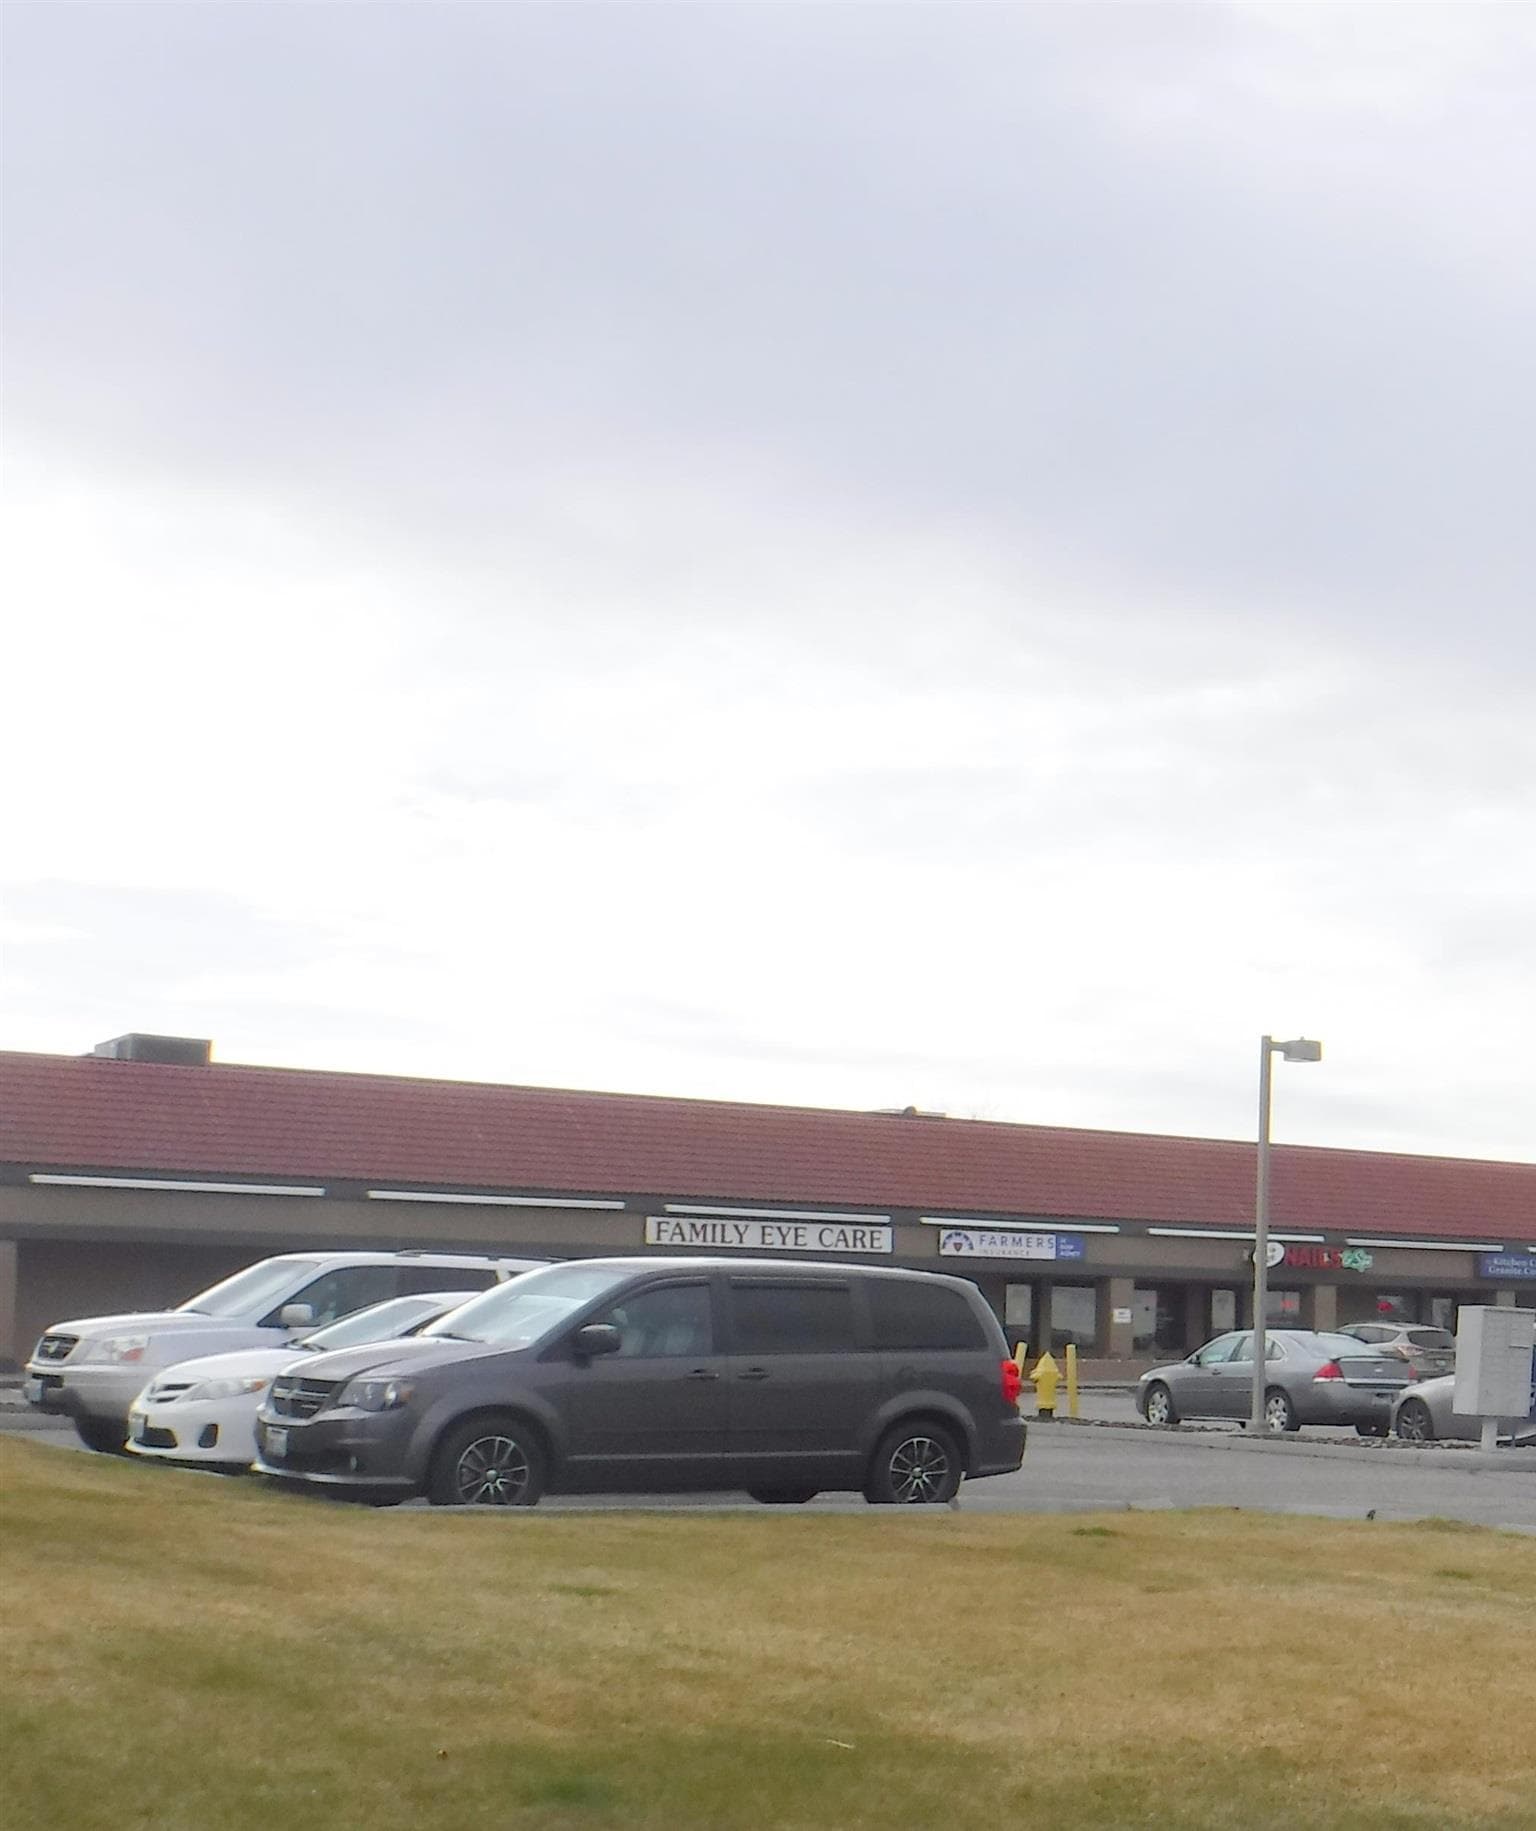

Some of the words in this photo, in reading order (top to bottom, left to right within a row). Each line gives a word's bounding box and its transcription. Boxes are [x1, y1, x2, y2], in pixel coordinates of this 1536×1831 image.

[655, 1221, 749, 1244] FAMILY
[760, 1225, 808, 1247] EYE
[818, 1227, 883, 1249] CARE
[980, 1234, 1055, 1249] FARMERS
